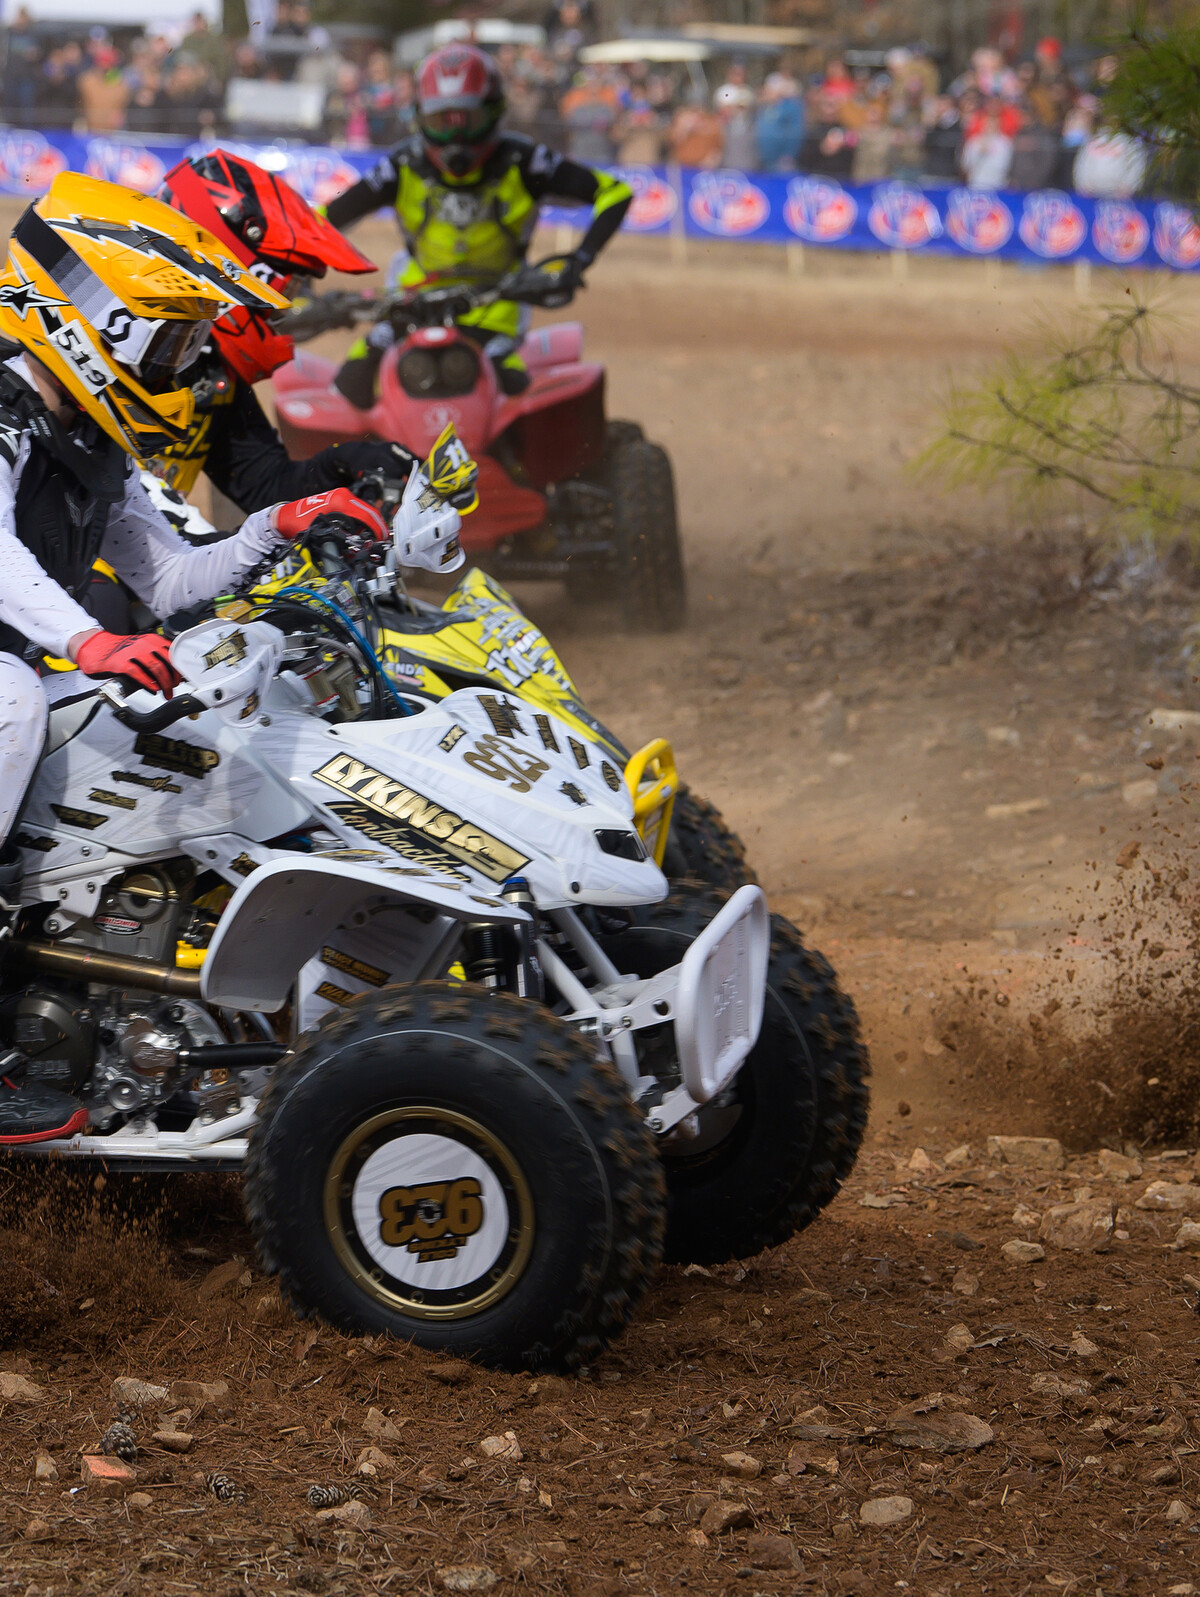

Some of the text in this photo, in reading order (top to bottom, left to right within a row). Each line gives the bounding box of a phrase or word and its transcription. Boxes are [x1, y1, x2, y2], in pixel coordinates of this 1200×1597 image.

[56, 327, 108, 387] 519
[444, 438, 470, 470] 11
[463, 733, 551, 793] 923
[317, 753, 462, 838] LYKINS
[380, 1178, 483, 1246] 923
